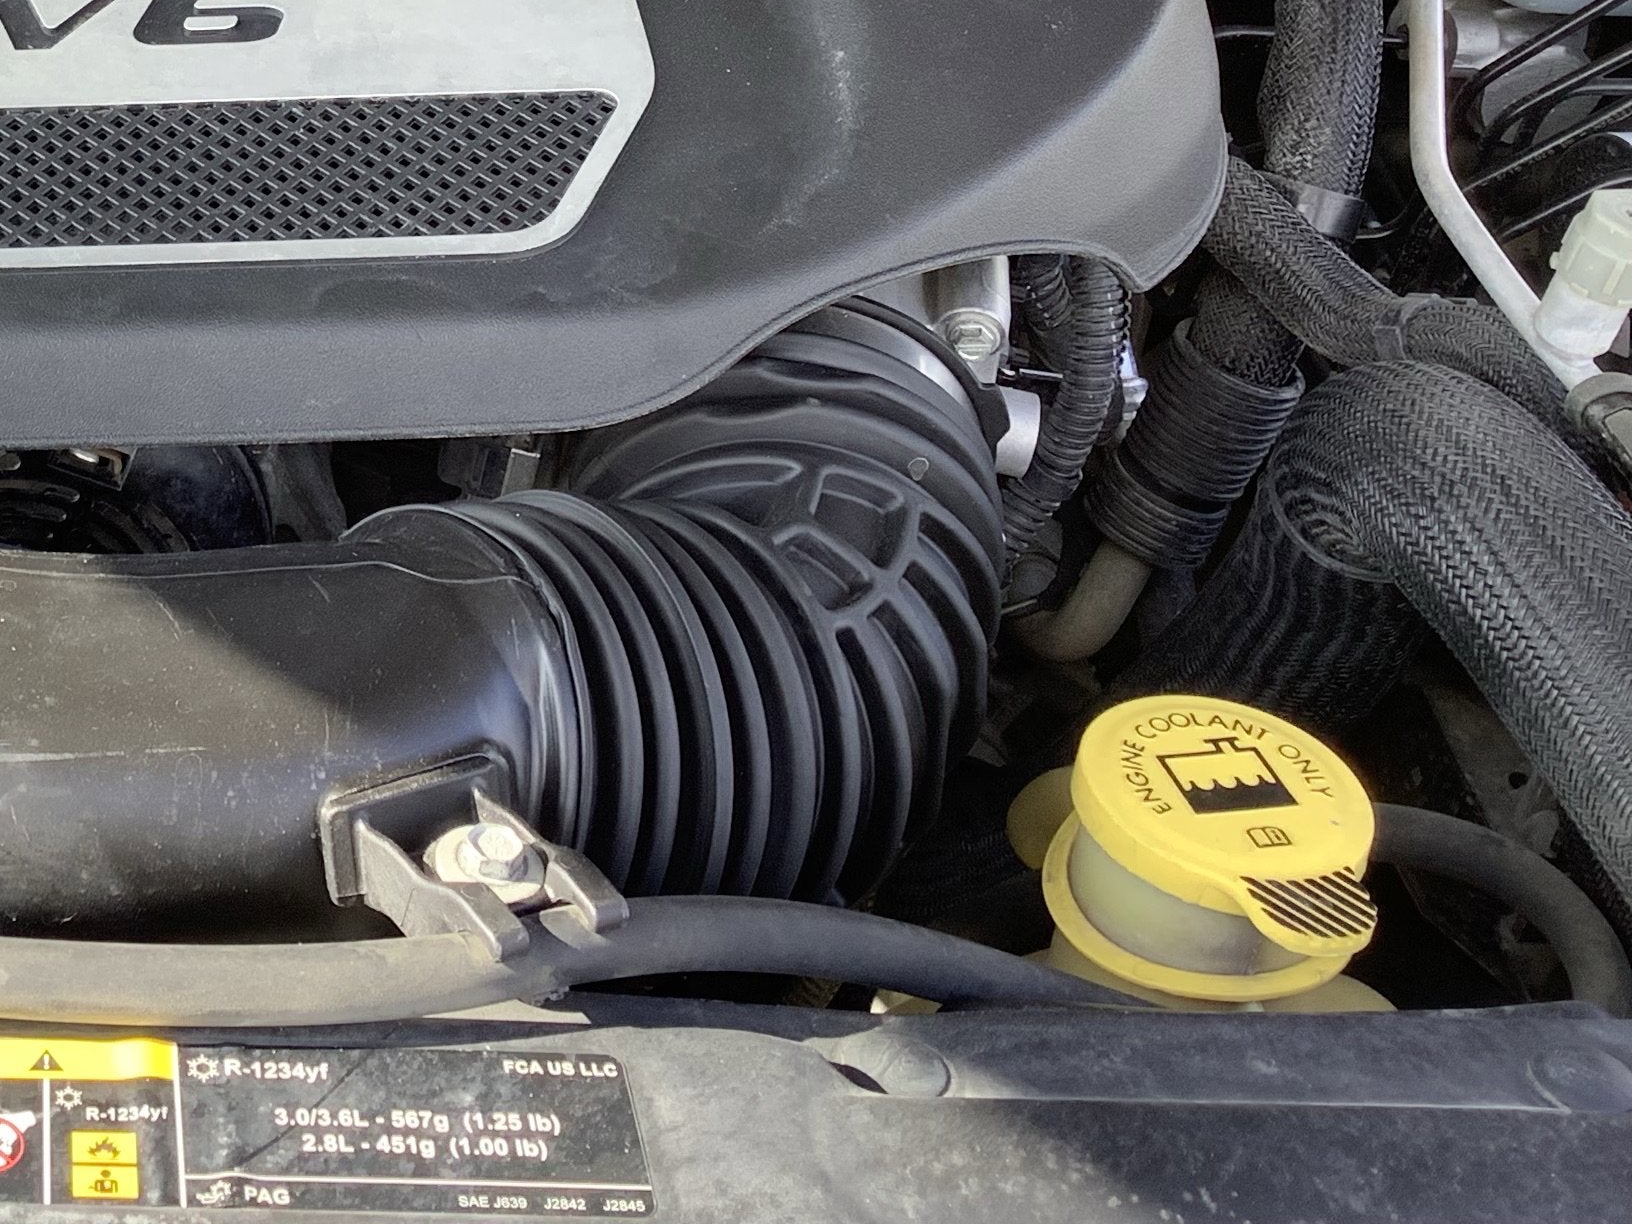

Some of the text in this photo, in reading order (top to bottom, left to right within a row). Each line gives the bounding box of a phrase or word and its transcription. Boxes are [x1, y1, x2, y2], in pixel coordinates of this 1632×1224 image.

[1120, 712, 1335, 815] ENGINE COOLANT ONLY
[223, 1058, 329, 1083] R-1234yf
[503, 1059, 618, 1077] FCA US LLC
[85, 1105, 169, 1122] R-1234yf
[274, 1107, 370, 1128] 3.0/3.6L
[391, 1109, 450, 1133] 567g
[463, 1112, 523, 1134] (1.25
[527, 1113, 561, 1136] lb)
[301, 1133, 355, 1153] 2.8L
[376, 1134, 436, 1159] 451g
[449, 1137, 509, 1160] (1.00
[515, 1138, 549, 1162] lb)
[243, 1185, 291, 1205] PAG
[457, 1195, 646, 1212] SAE J639 J2842 J2845
